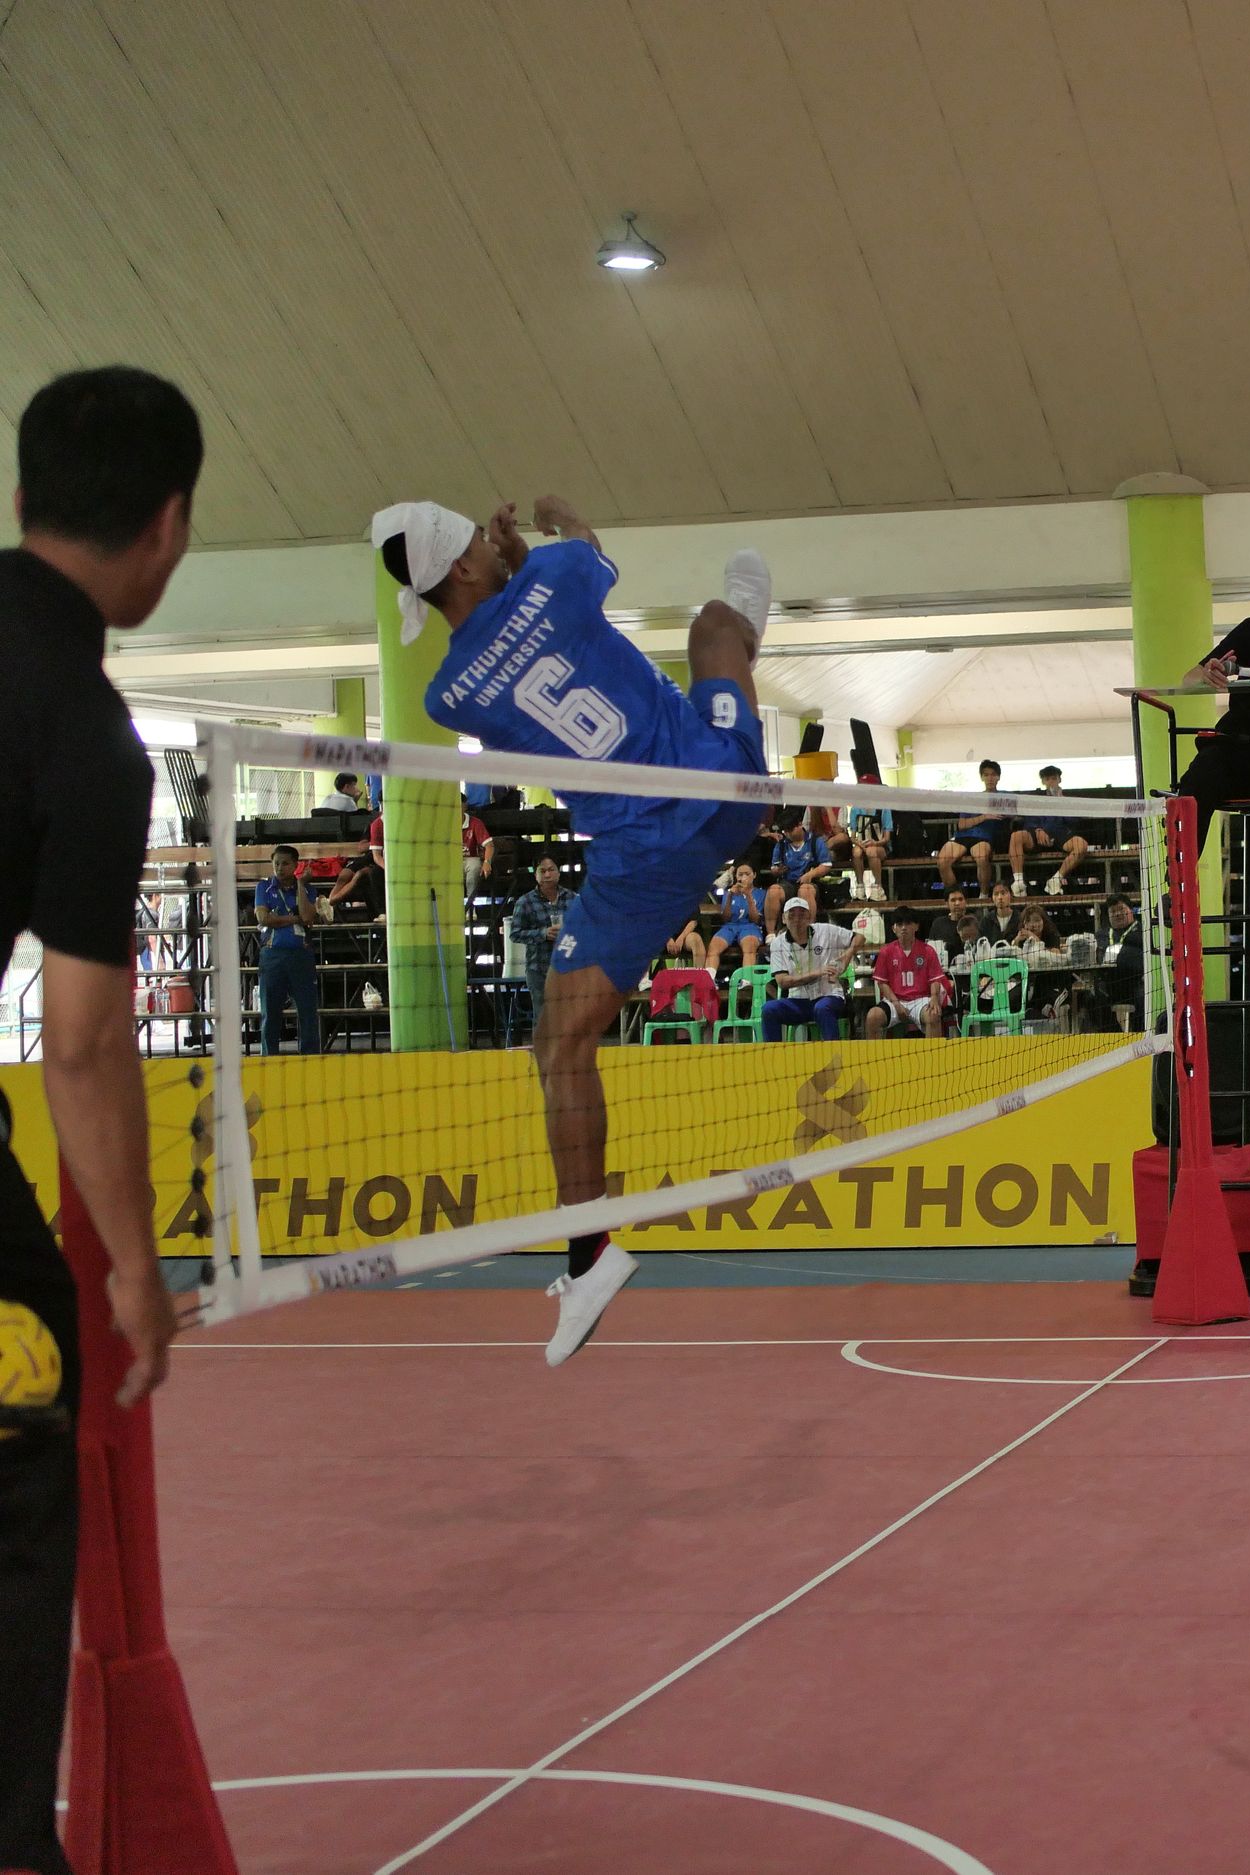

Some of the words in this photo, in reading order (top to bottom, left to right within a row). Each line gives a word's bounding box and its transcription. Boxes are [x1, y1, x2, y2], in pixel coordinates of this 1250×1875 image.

[441, 583, 554, 709] PATHUMTHANI
[475, 617, 555, 707] UNIVERSITY
[513, 652, 628, 760] 6
[901, 971, 914, 987] 10
[606, 1162, 1110, 1232] ARATHON
